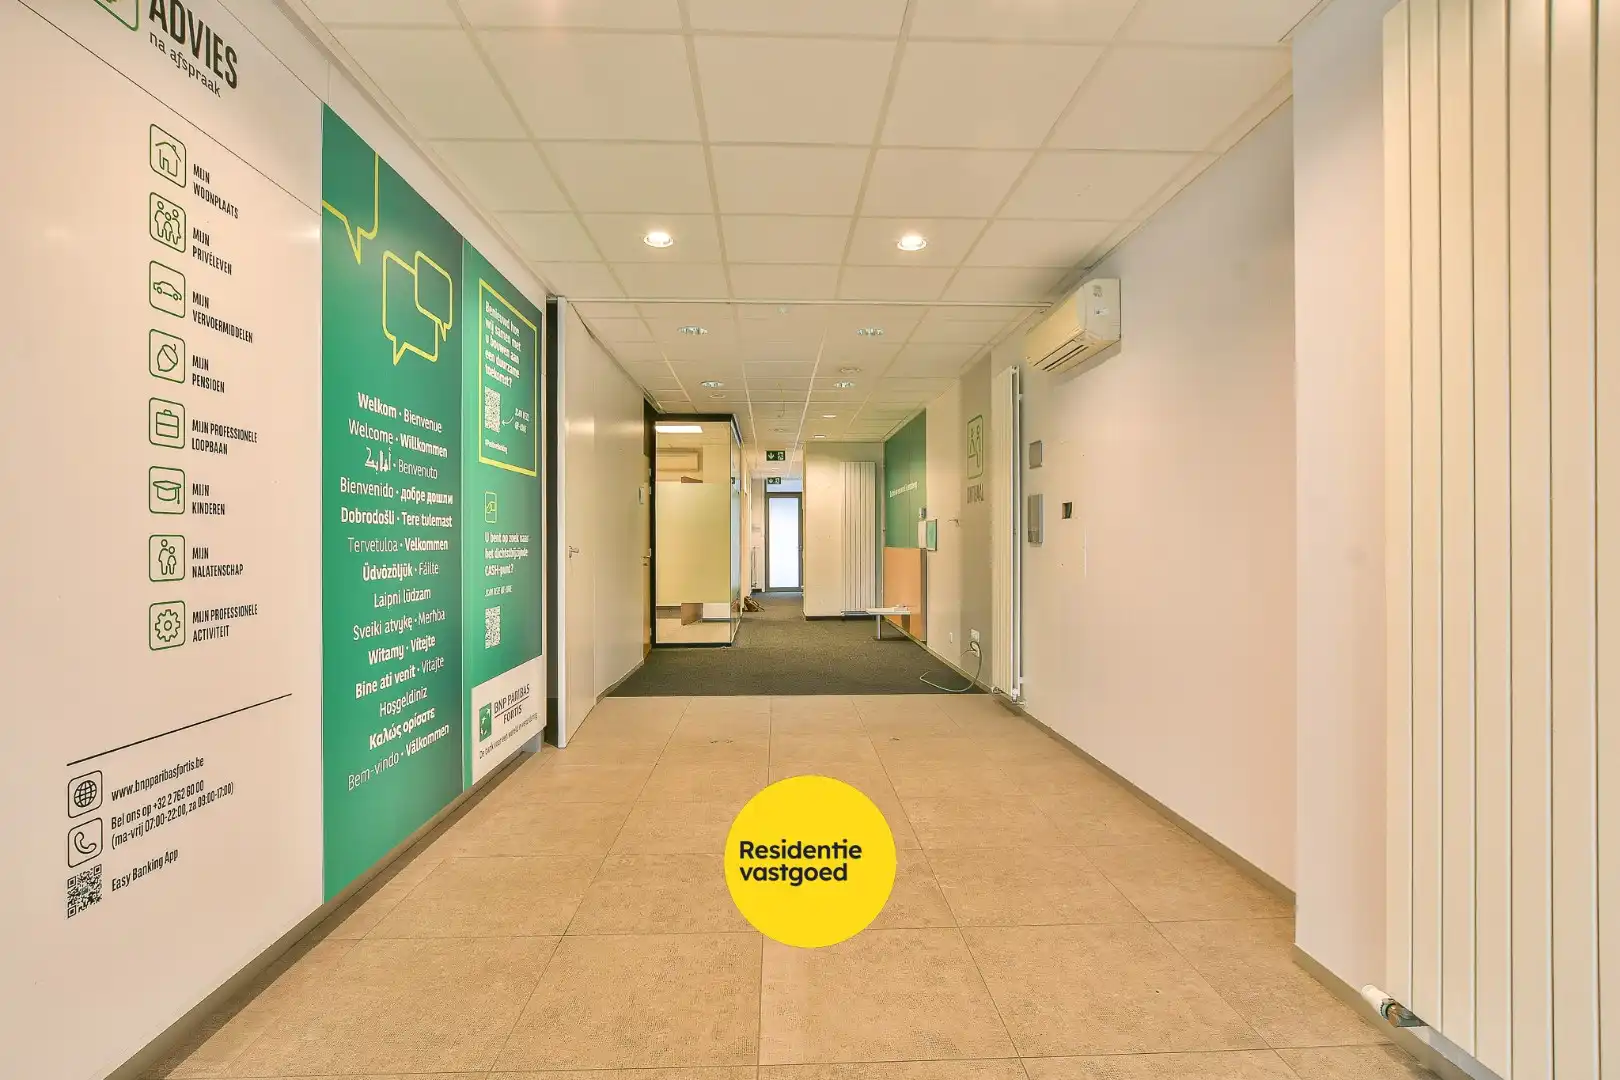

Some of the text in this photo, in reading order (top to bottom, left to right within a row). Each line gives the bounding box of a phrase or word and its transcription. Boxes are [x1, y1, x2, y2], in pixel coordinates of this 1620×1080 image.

[148, 0, 238, 90] ADVIES
[149, 31, 221, 98] na afspraak
[193, 163, 210, 185] MIJN
[193, 182, 239, 220] WOONPLAATS
[192, 227, 210, 247] MIJN
[192, 245, 233, 276] PRIVÉLEVEN
[192, 291, 210, 309] MIJN
[192, 310, 253, 343] VERVOERMIDDELEN
[192, 355, 209, 372] MIJN
[192, 373, 225, 394] PENSIOEN
[357, 391, 443, 433] Welkom Bienvenue
[192, 419, 258, 444] MIJN PROFESSIONELE
[348, 418, 448, 459] Welcome Willkommen
[191, 437, 228, 456] LOOPBAAN
[398, 458, 438, 480] Benvenuto
[192, 483, 210, 497] MIJN
[340, 476, 394, 499] Bienvenido
[400, 487, 453, 505] добре дошли
[192, 502, 226, 515] KINDEREN
[341, 507, 453, 528] Dobrodošli Tere tulemast
[192, 547, 209, 560] MIJN
[347, 537, 449, 553] Tervetuloa Velkommen
[192, 563, 244, 578] NALATENSCHAP
[362, 562, 439, 582] Üdvözöljük Fáilte
[373, 591, 401, 610] Laipni
[192, 604, 258, 624] MIJN PROFESSIONELE
[192, 625, 230, 643] ACTIVITEIT
[353, 621, 382, 641] Sveiki
[368, 644, 405, 665] Witamy
[355, 678, 378, 699] Bine
[394, 664, 416, 683] venit
[494, 683, 530, 714] BNP PARIBAS
[503, 704, 522, 724] FORTIS
[369, 707, 436, 751] Καλώς ορίσατε
[348, 723, 450, 792] Bem-vindo Välkommen
[111, 756, 204, 802] www.bnpparibasfortis.be
[111, 811, 125, 830] Bel
[127, 807, 141, 823] ons
[141, 804, 152, 820] op
[153, 797, 167, 813] +32
[167, 795, 172, 808] 2
[173, 787, 186, 805] 762
[195, 779, 204, 796] 00
[111, 781, 234, 850] (ma-vrij 07:00-22:00, za 09:00-17:00)
[111, 848, 179, 893] Easy Banking App
